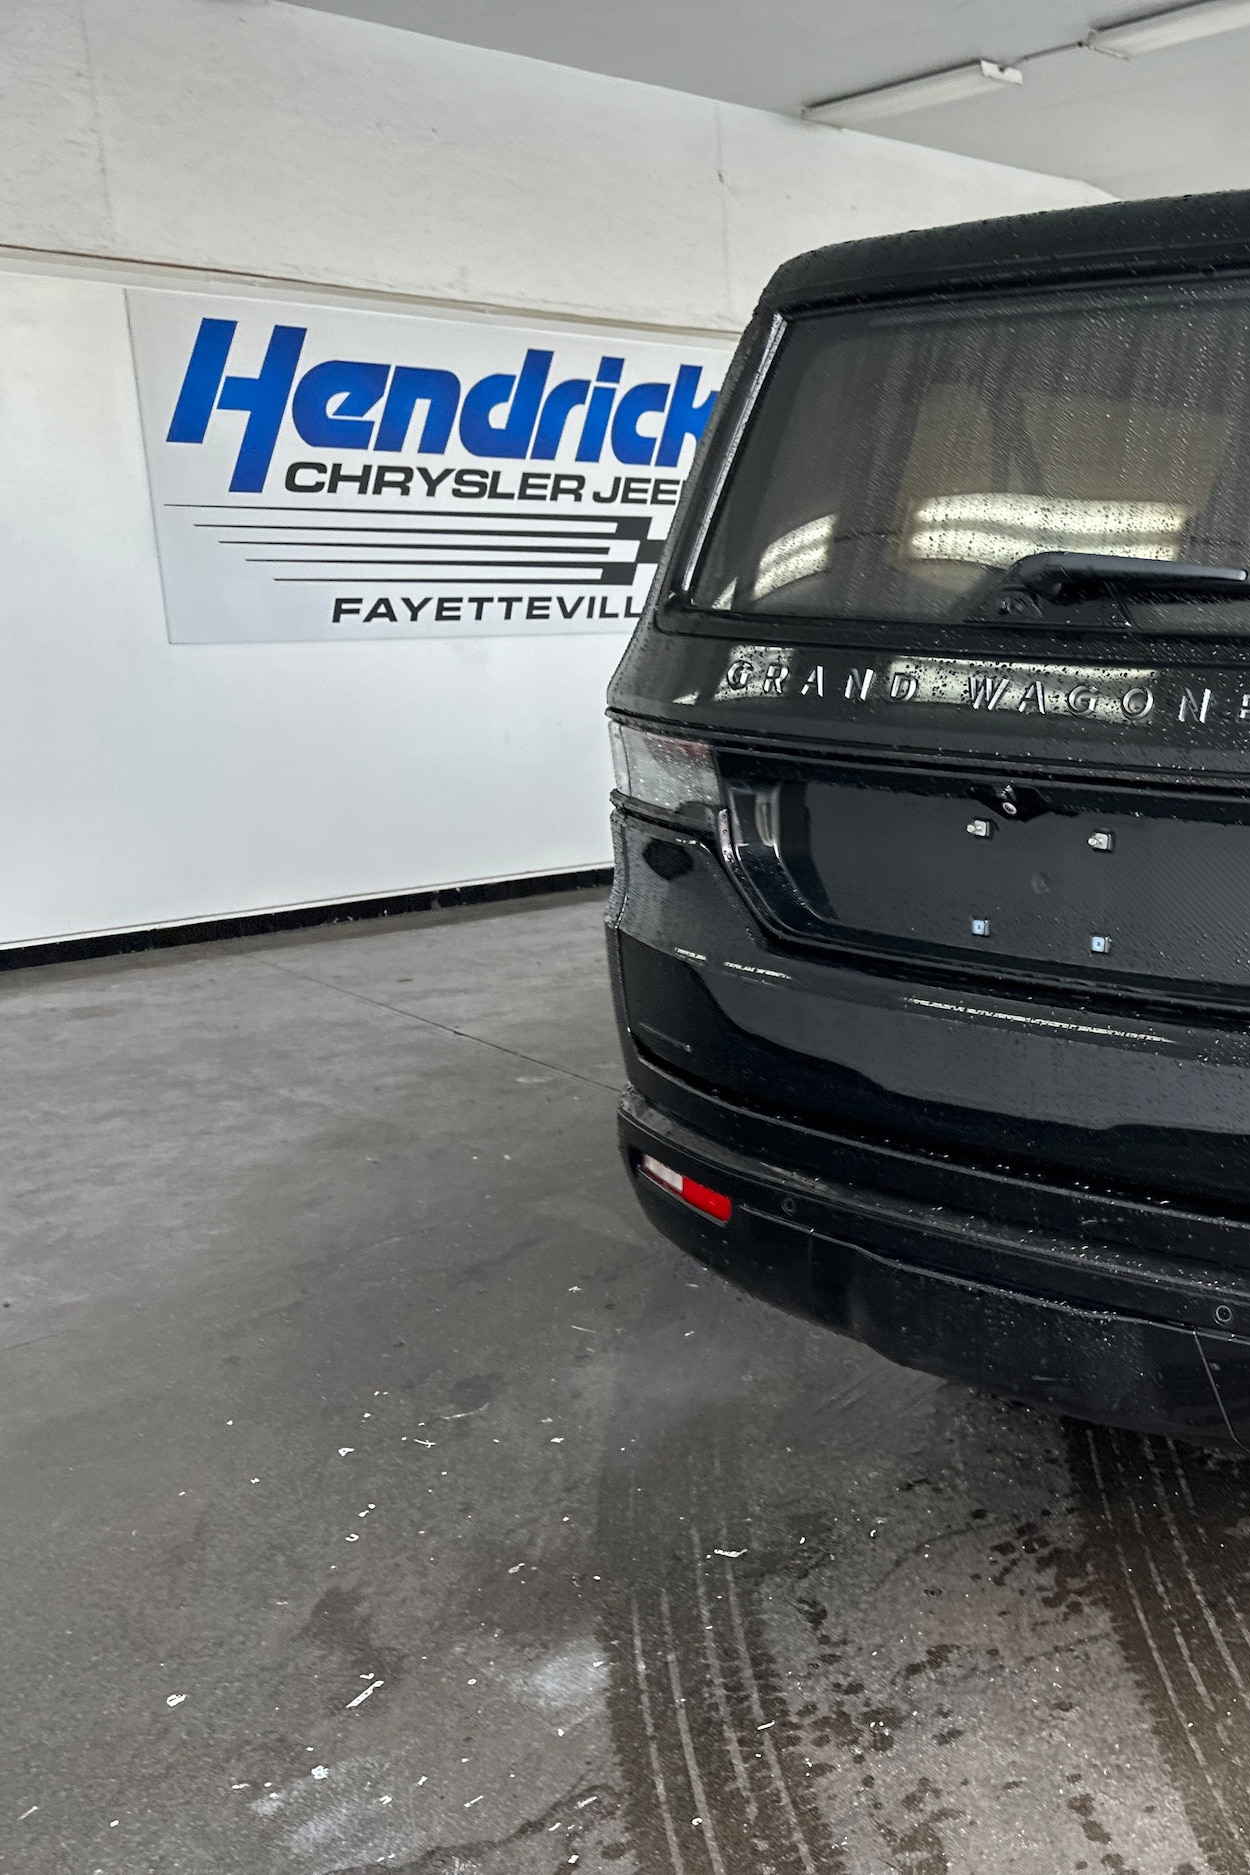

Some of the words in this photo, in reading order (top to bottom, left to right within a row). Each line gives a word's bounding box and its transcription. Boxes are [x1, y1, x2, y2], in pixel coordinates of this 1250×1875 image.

[166, 317, 719, 493] Hendrick
[284, 461, 585, 503] CHRYSLER
[592, 476, 686, 505] JEE
[725, 659, 919, 700] GRAND
